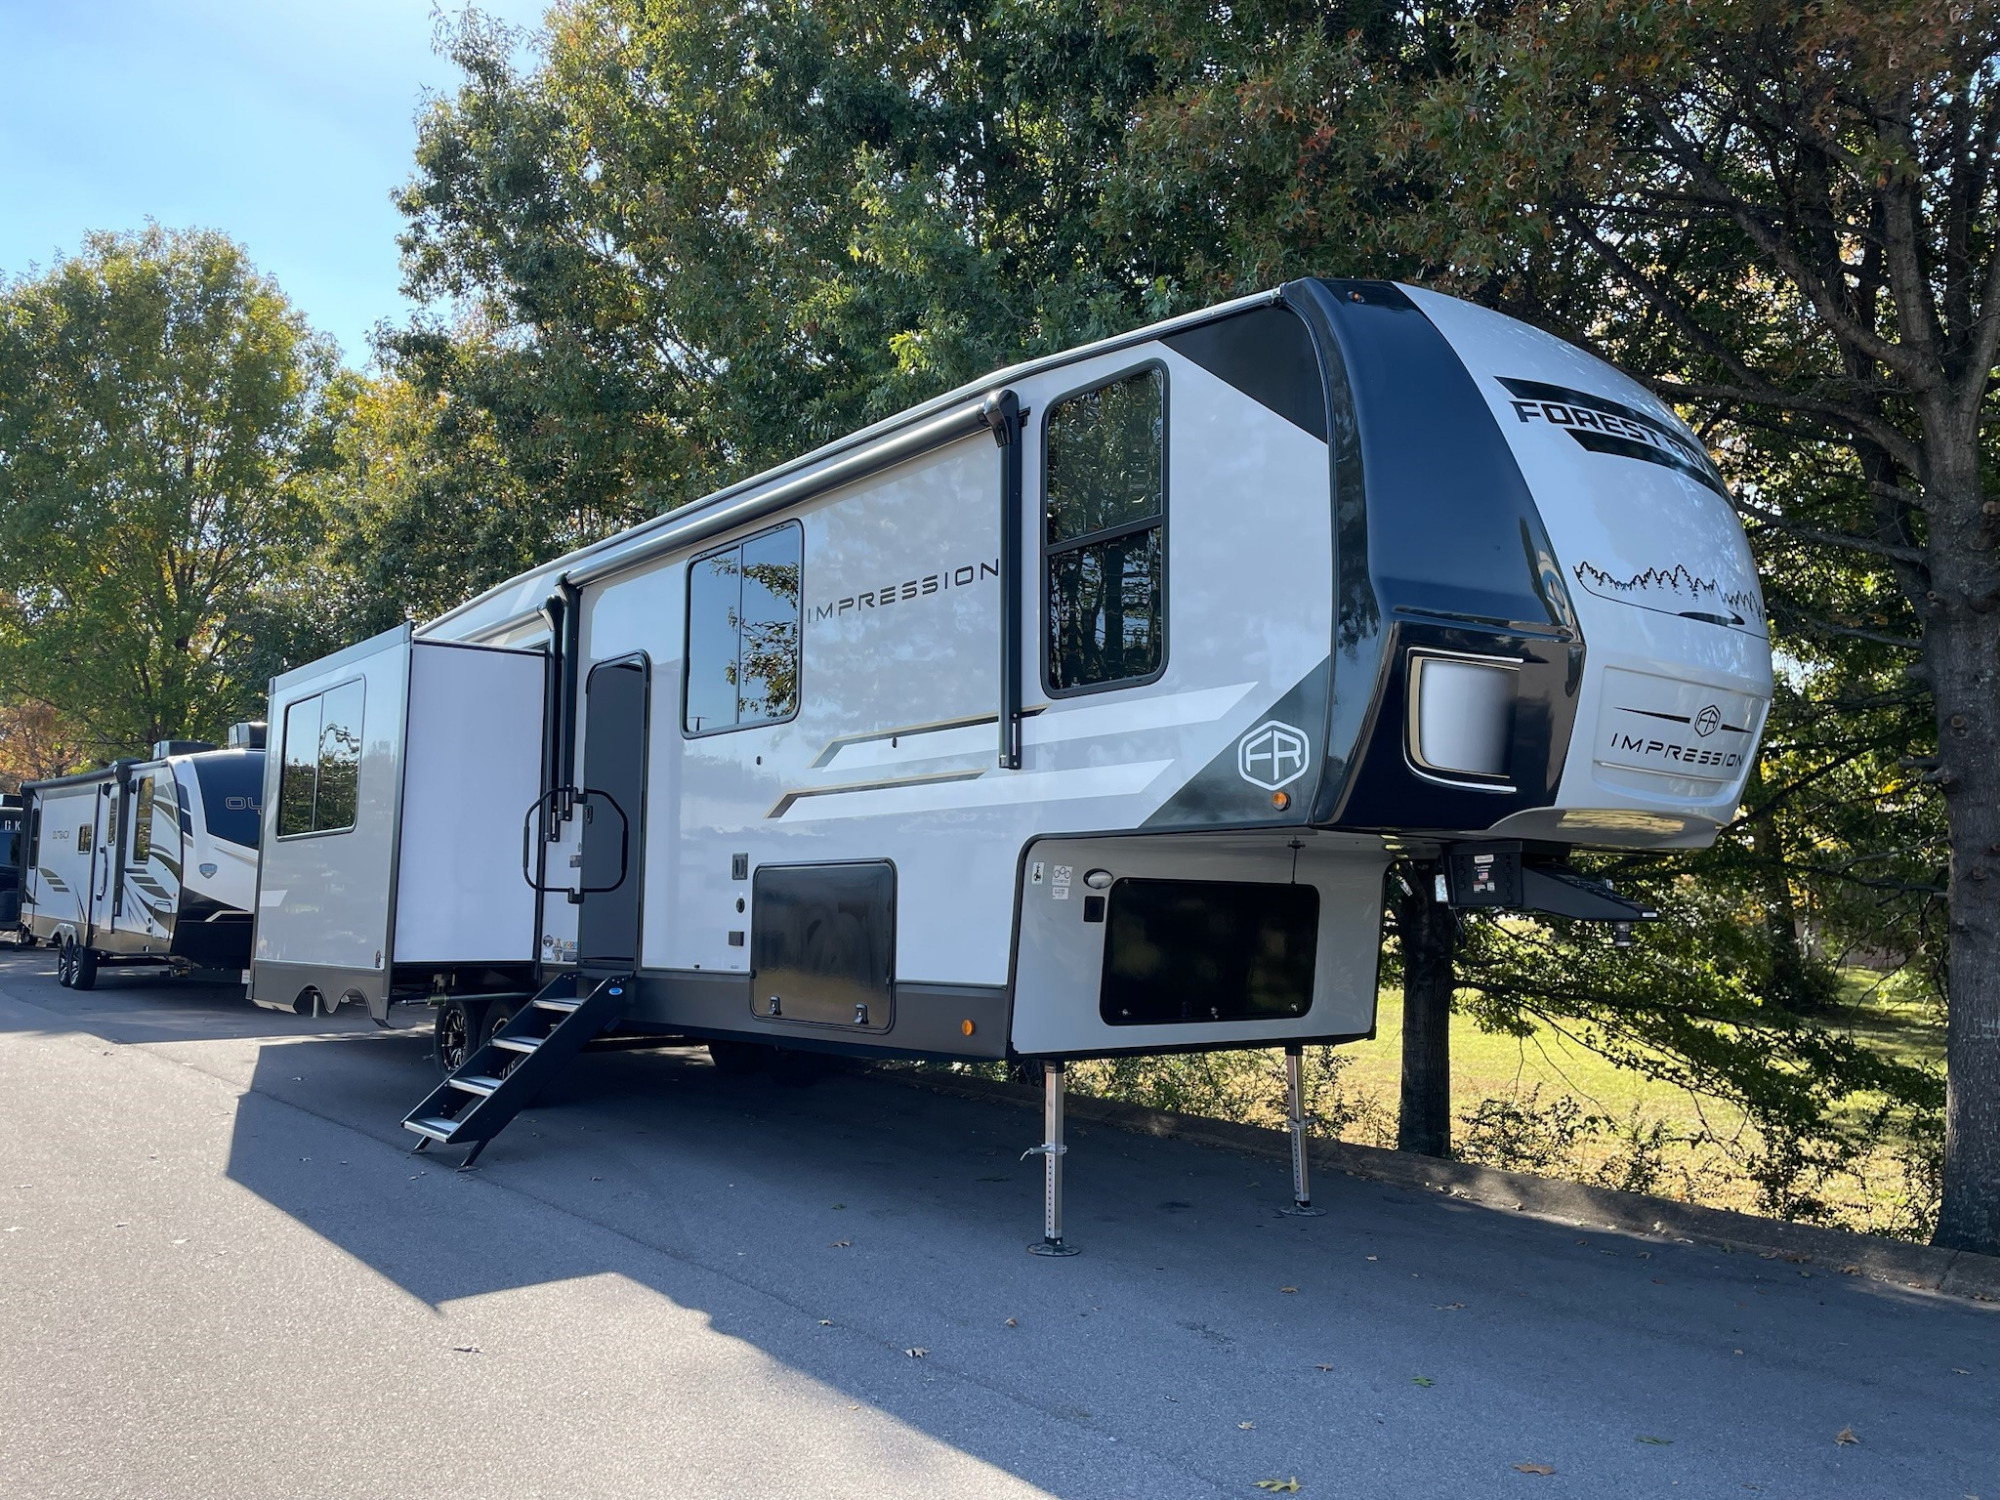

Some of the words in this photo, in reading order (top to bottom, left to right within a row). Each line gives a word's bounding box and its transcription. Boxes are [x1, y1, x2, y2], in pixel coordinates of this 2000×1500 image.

[1509, 400, 1661, 447] FOREST
[807, 558, 999, 624] IMPRESSION
[1611, 733, 1745, 767] IMPRESSION
